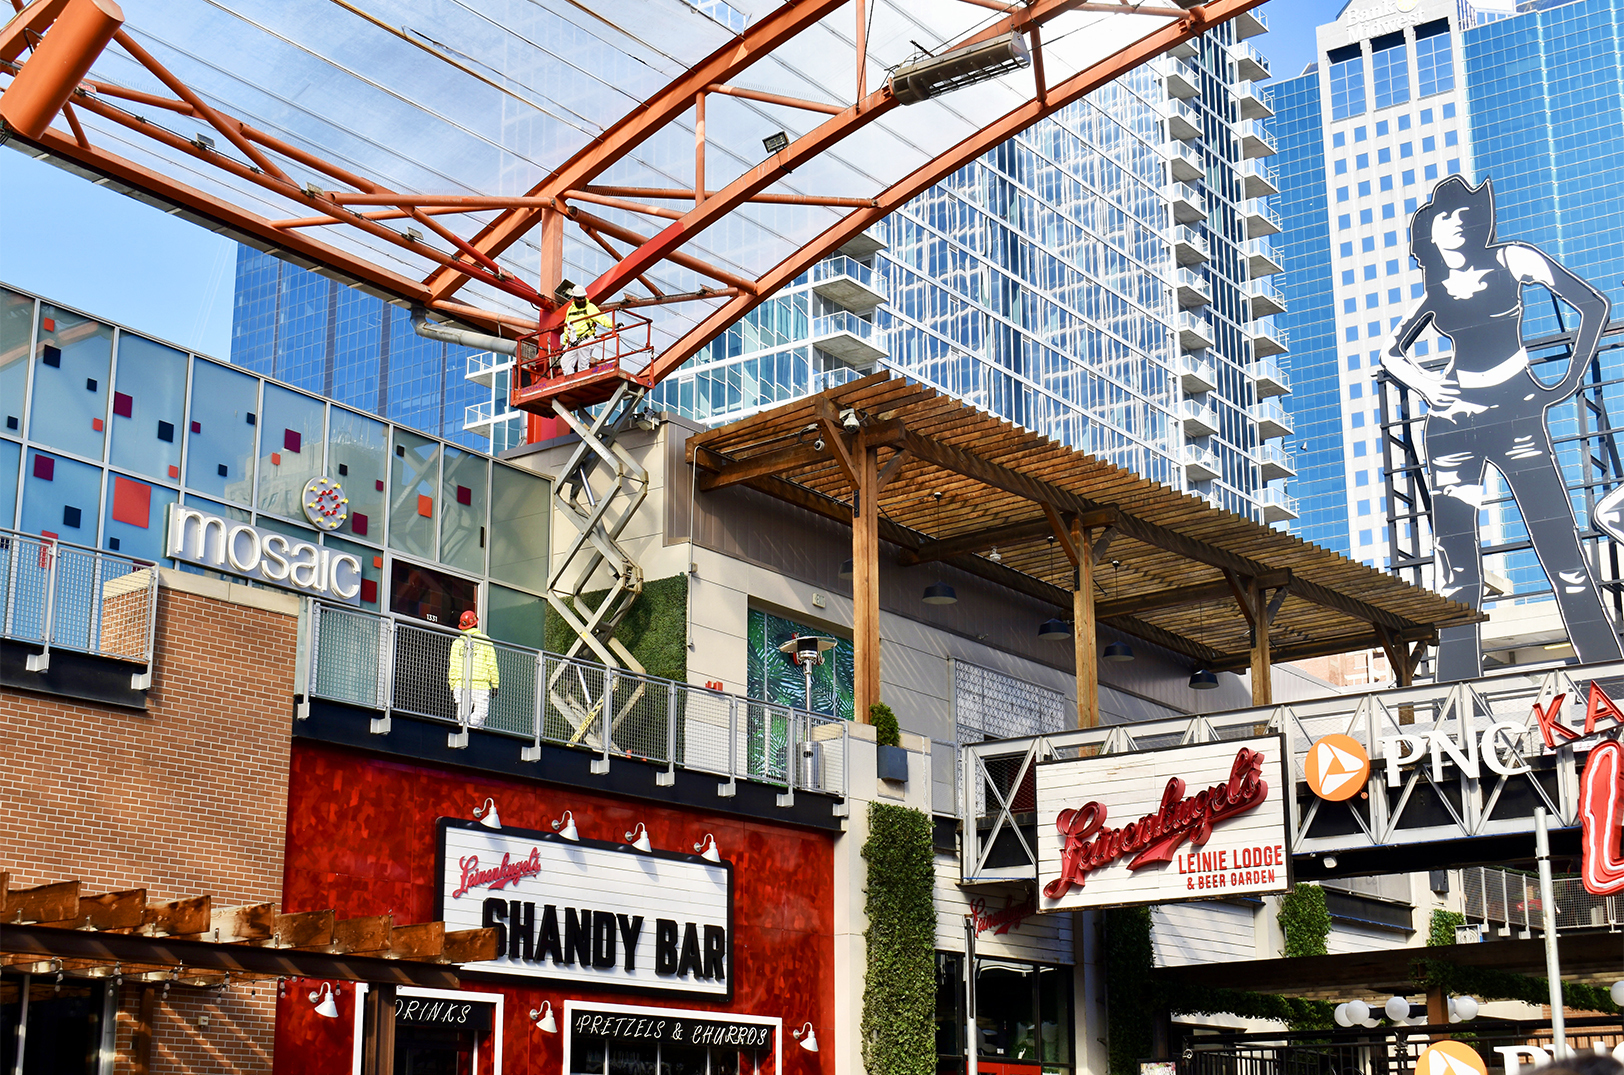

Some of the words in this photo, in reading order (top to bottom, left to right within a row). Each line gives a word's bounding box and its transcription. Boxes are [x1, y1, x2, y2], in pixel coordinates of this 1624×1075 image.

[1345, 0, 1396, 27] Bank
[1346, 7, 1425, 45] Midwest
[174, 508, 360, 600] mosaic
[1378, 721, 1532, 788] PNC
[1043, 747, 1269, 900] Leinenkugel's
[452, 847, 541, 899] Leinenkugel's
[1178, 850, 1228, 875] LEINIE
[1233, 844, 1284, 870] LODGE
[1186, 876, 1196, 890] &
[1198, 872, 1227, 889] BEER
[1230, 868, 1276, 886] GARDEN
[482, 897, 645, 970] SHANDY
[655, 918, 726, 981] BAR
[575, 1014, 666, 1039] PRETZELS
[671, 1022, 683, 1040] &
[692, 1024, 768, 1046] CHURROS
